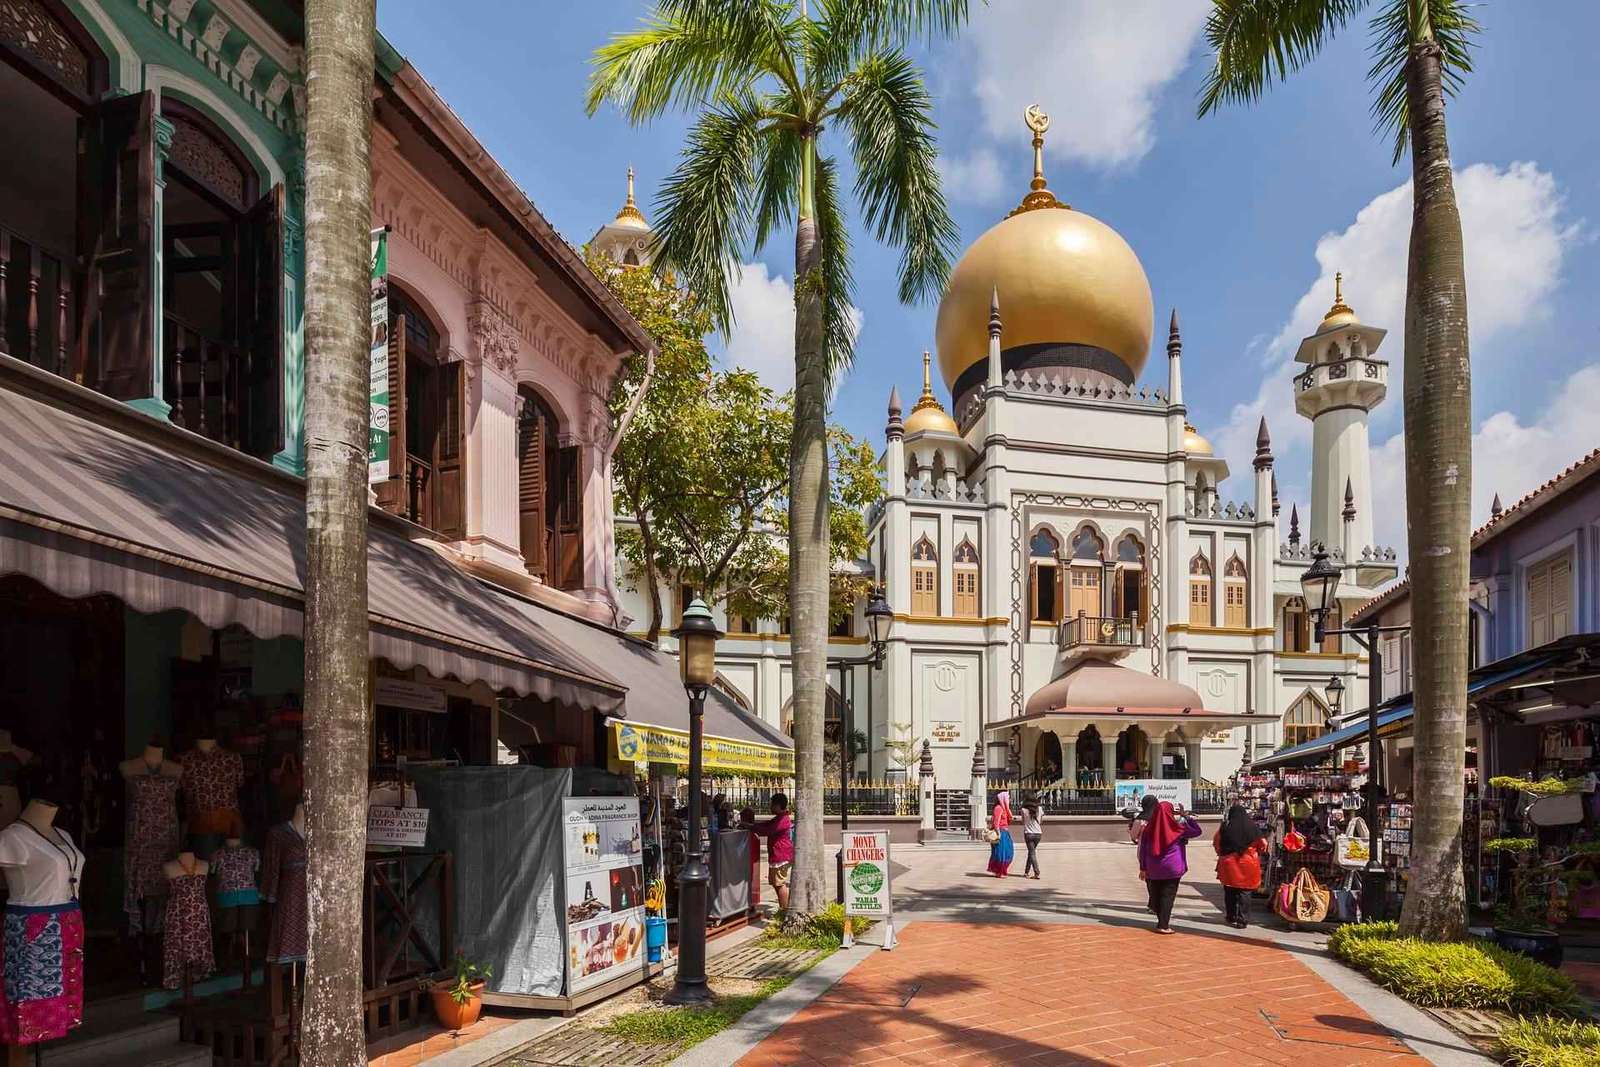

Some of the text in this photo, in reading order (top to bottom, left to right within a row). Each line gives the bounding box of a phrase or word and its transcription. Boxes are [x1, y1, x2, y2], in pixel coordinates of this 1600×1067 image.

[370, 819, 395, 827] TOPS
[853, 836, 877, 848] MONEY
[847, 848, 885, 860] CHANGERS
